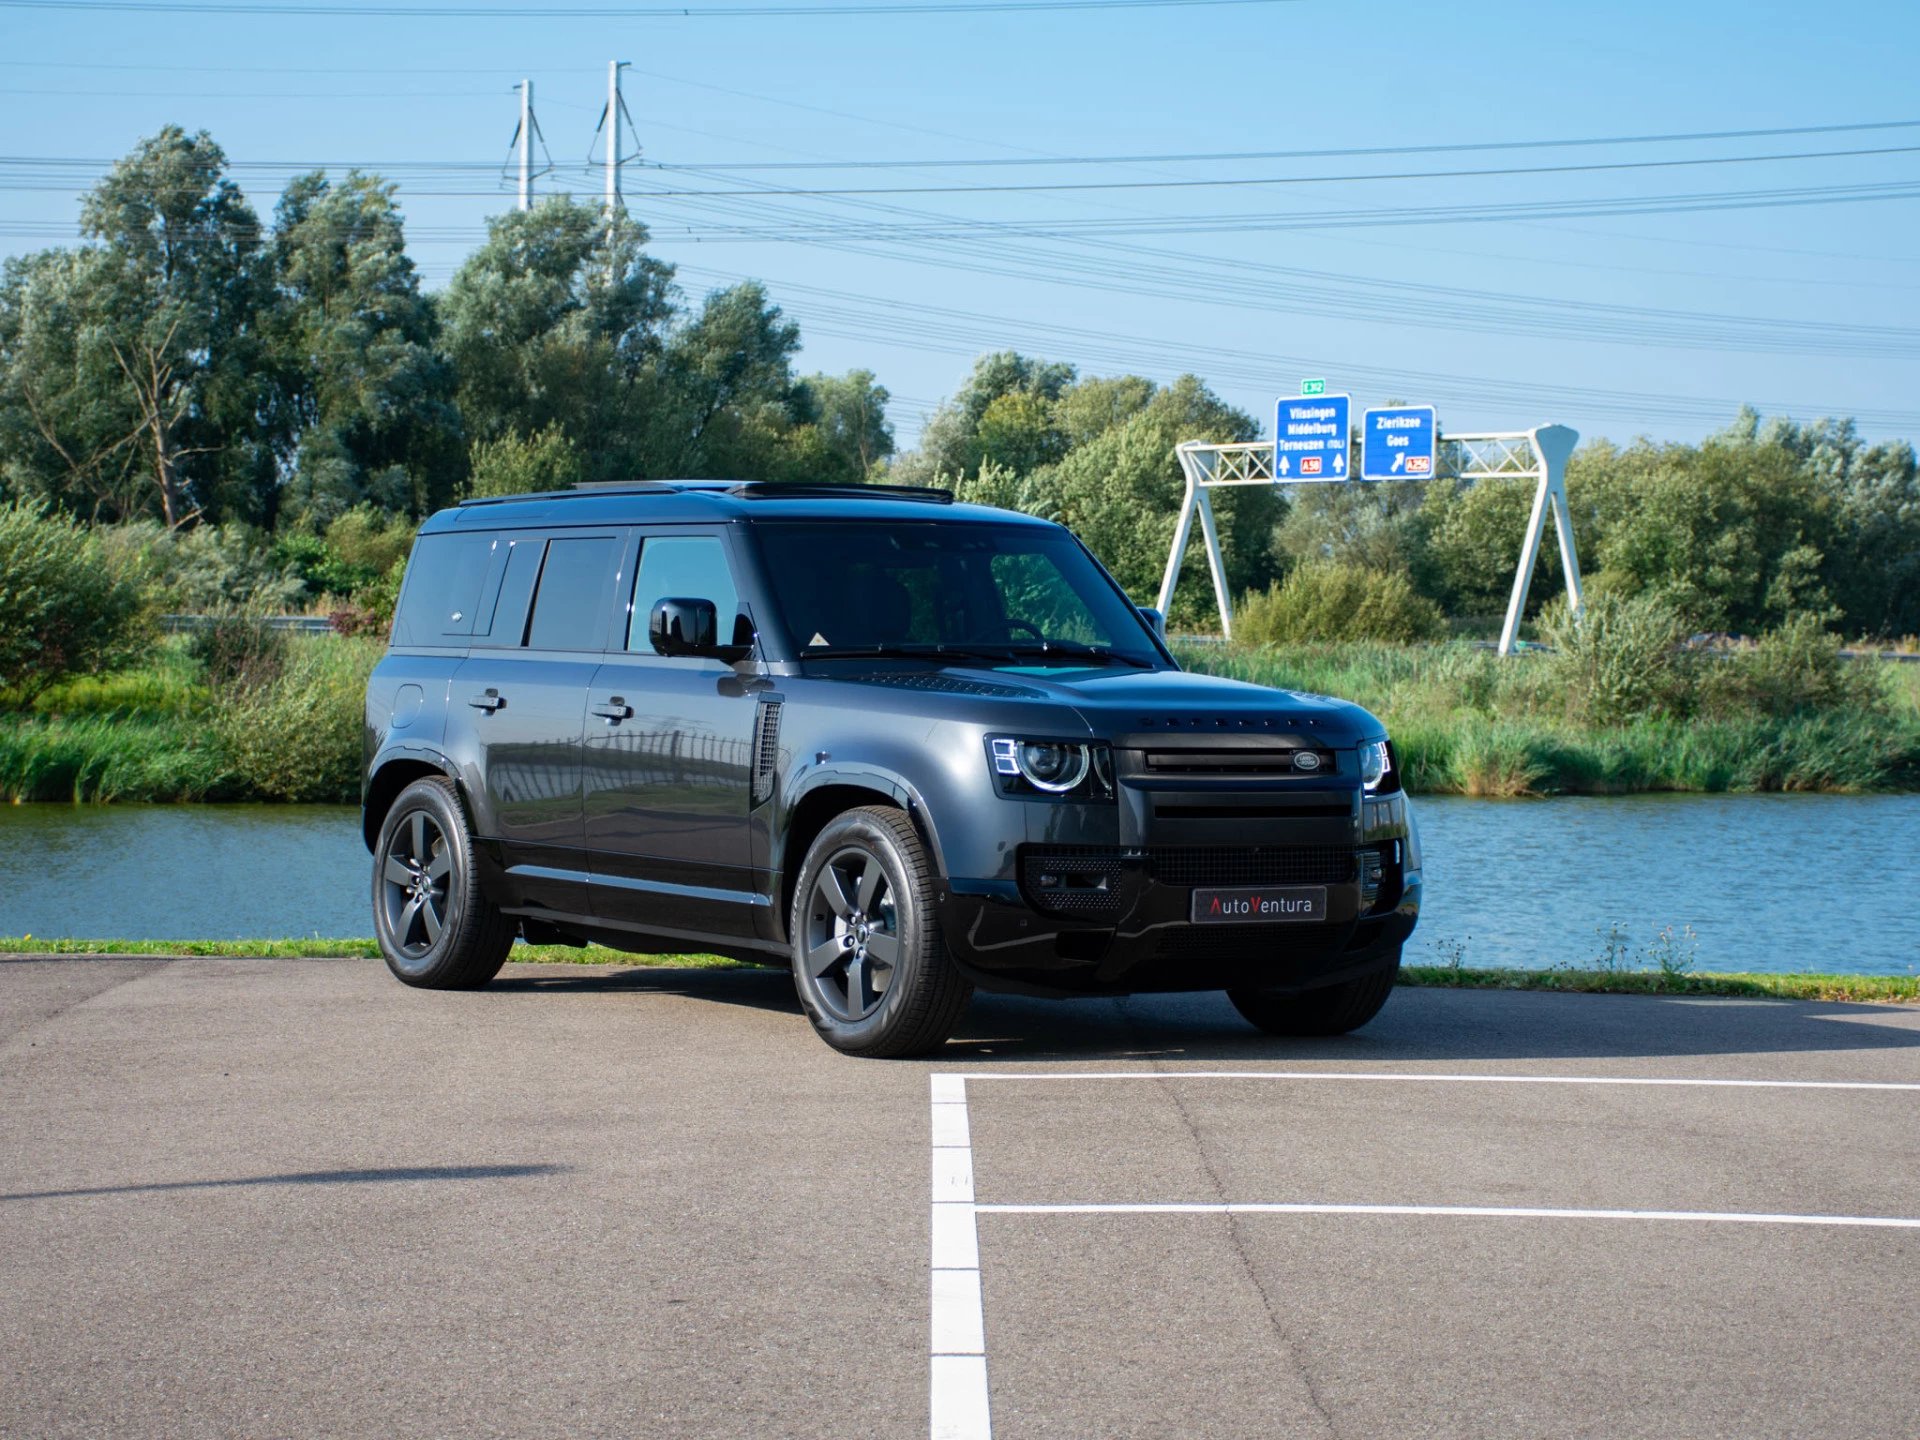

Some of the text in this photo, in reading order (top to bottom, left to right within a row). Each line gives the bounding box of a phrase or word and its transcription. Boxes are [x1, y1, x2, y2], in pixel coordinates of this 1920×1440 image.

[1290, 407, 1336, 420] Vlissingen
[1377, 416, 1421, 429] Zierikzee
[1287, 423, 1336, 436] Middelburg
[1279, 439, 1325, 451] Terneuzen
[1386, 434, 1409, 447] Goes
[1210, 897, 1312, 914] AutoVentura
